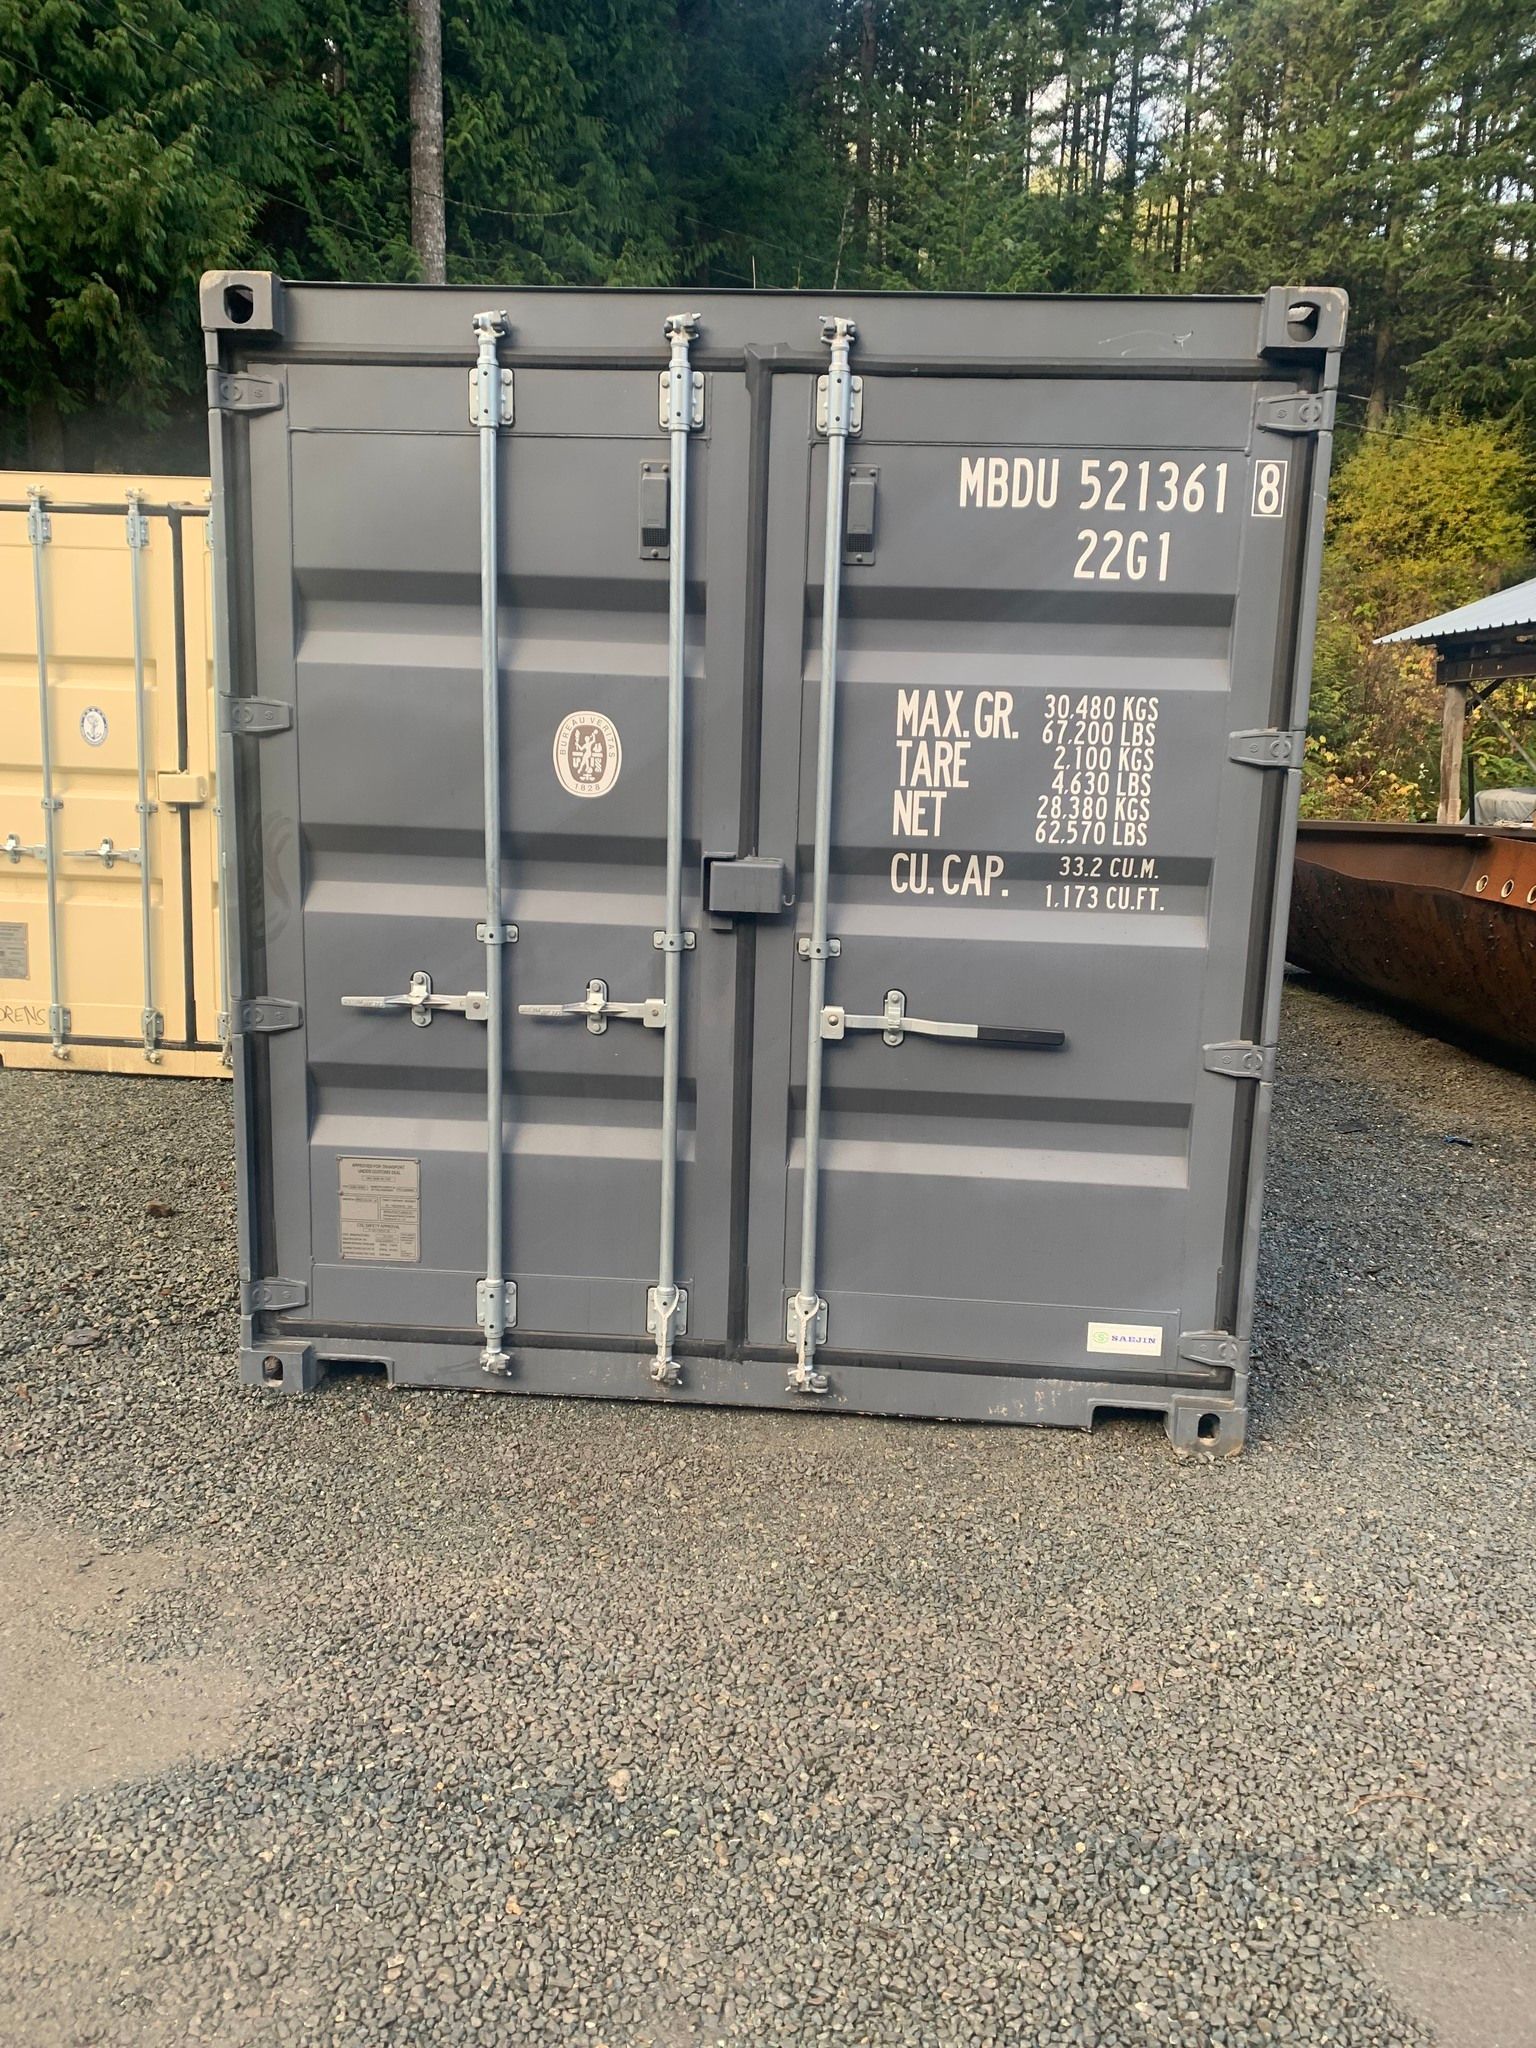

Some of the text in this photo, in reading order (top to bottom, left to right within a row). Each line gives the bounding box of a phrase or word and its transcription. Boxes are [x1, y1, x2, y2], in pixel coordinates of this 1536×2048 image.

[959, 456, 1283, 515] MBDU 521361 8
[1072, 528, 1171, 582] 22G1
[1043, 693, 1160, 722] 30,480 KGS
[560, 717, 616, 758] BUREAU VERITAS
[1041, 719, 1156, 748] 67,200 LBS
[895, 739, 972, 788] TARE
[1053, 745, 1155, 773] 2,100 KGS
[574, 783, 601, 792] 1828
[1051, 770, 1152, 798] 4,630 LBS
[892, 789, 948, 837] NET
[1036, 794, 1151, 823] 28,380 KGS
[1035, 819, 1148, 847] 62,570 LBS
[1059, 856, 1159, 880] 33.2 CU.M.
[1045, 884, 1165, 912] 1,173 CU.FT.
[1111, 1335, 1157, 1344] SAEJIN
